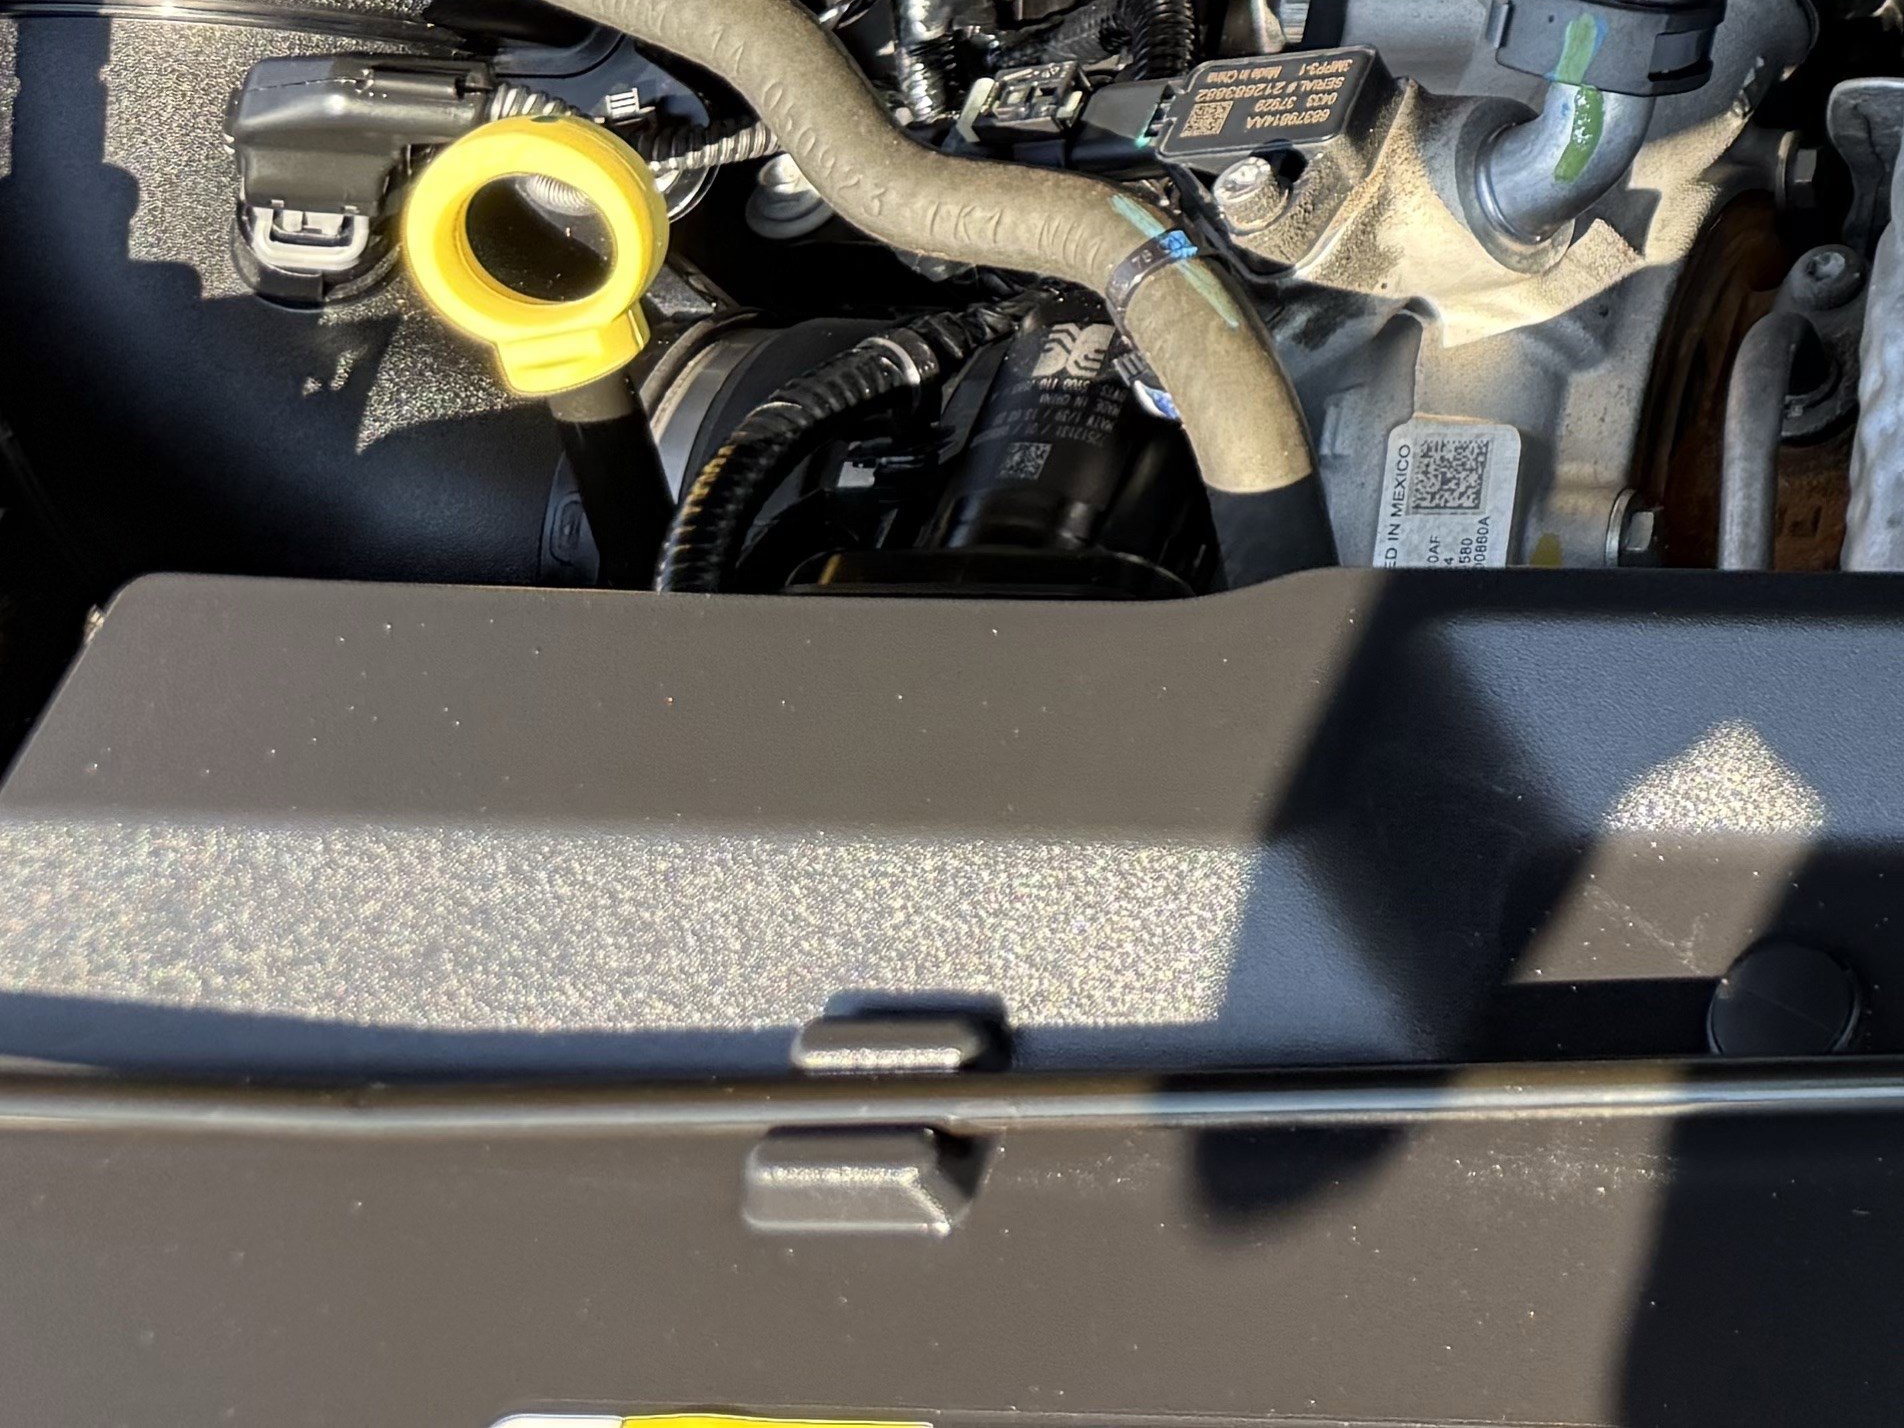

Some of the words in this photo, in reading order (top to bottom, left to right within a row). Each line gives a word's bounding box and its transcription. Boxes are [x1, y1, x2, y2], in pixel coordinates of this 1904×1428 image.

[1206, 70, 1238, 83] China
[1251, 65, 1282, 79] Made
[1300, 76, 1344, 91] SERIAL
[1392, 445, 1410, 517] MEXICO
[1389, 524, 1401, 540] IN
